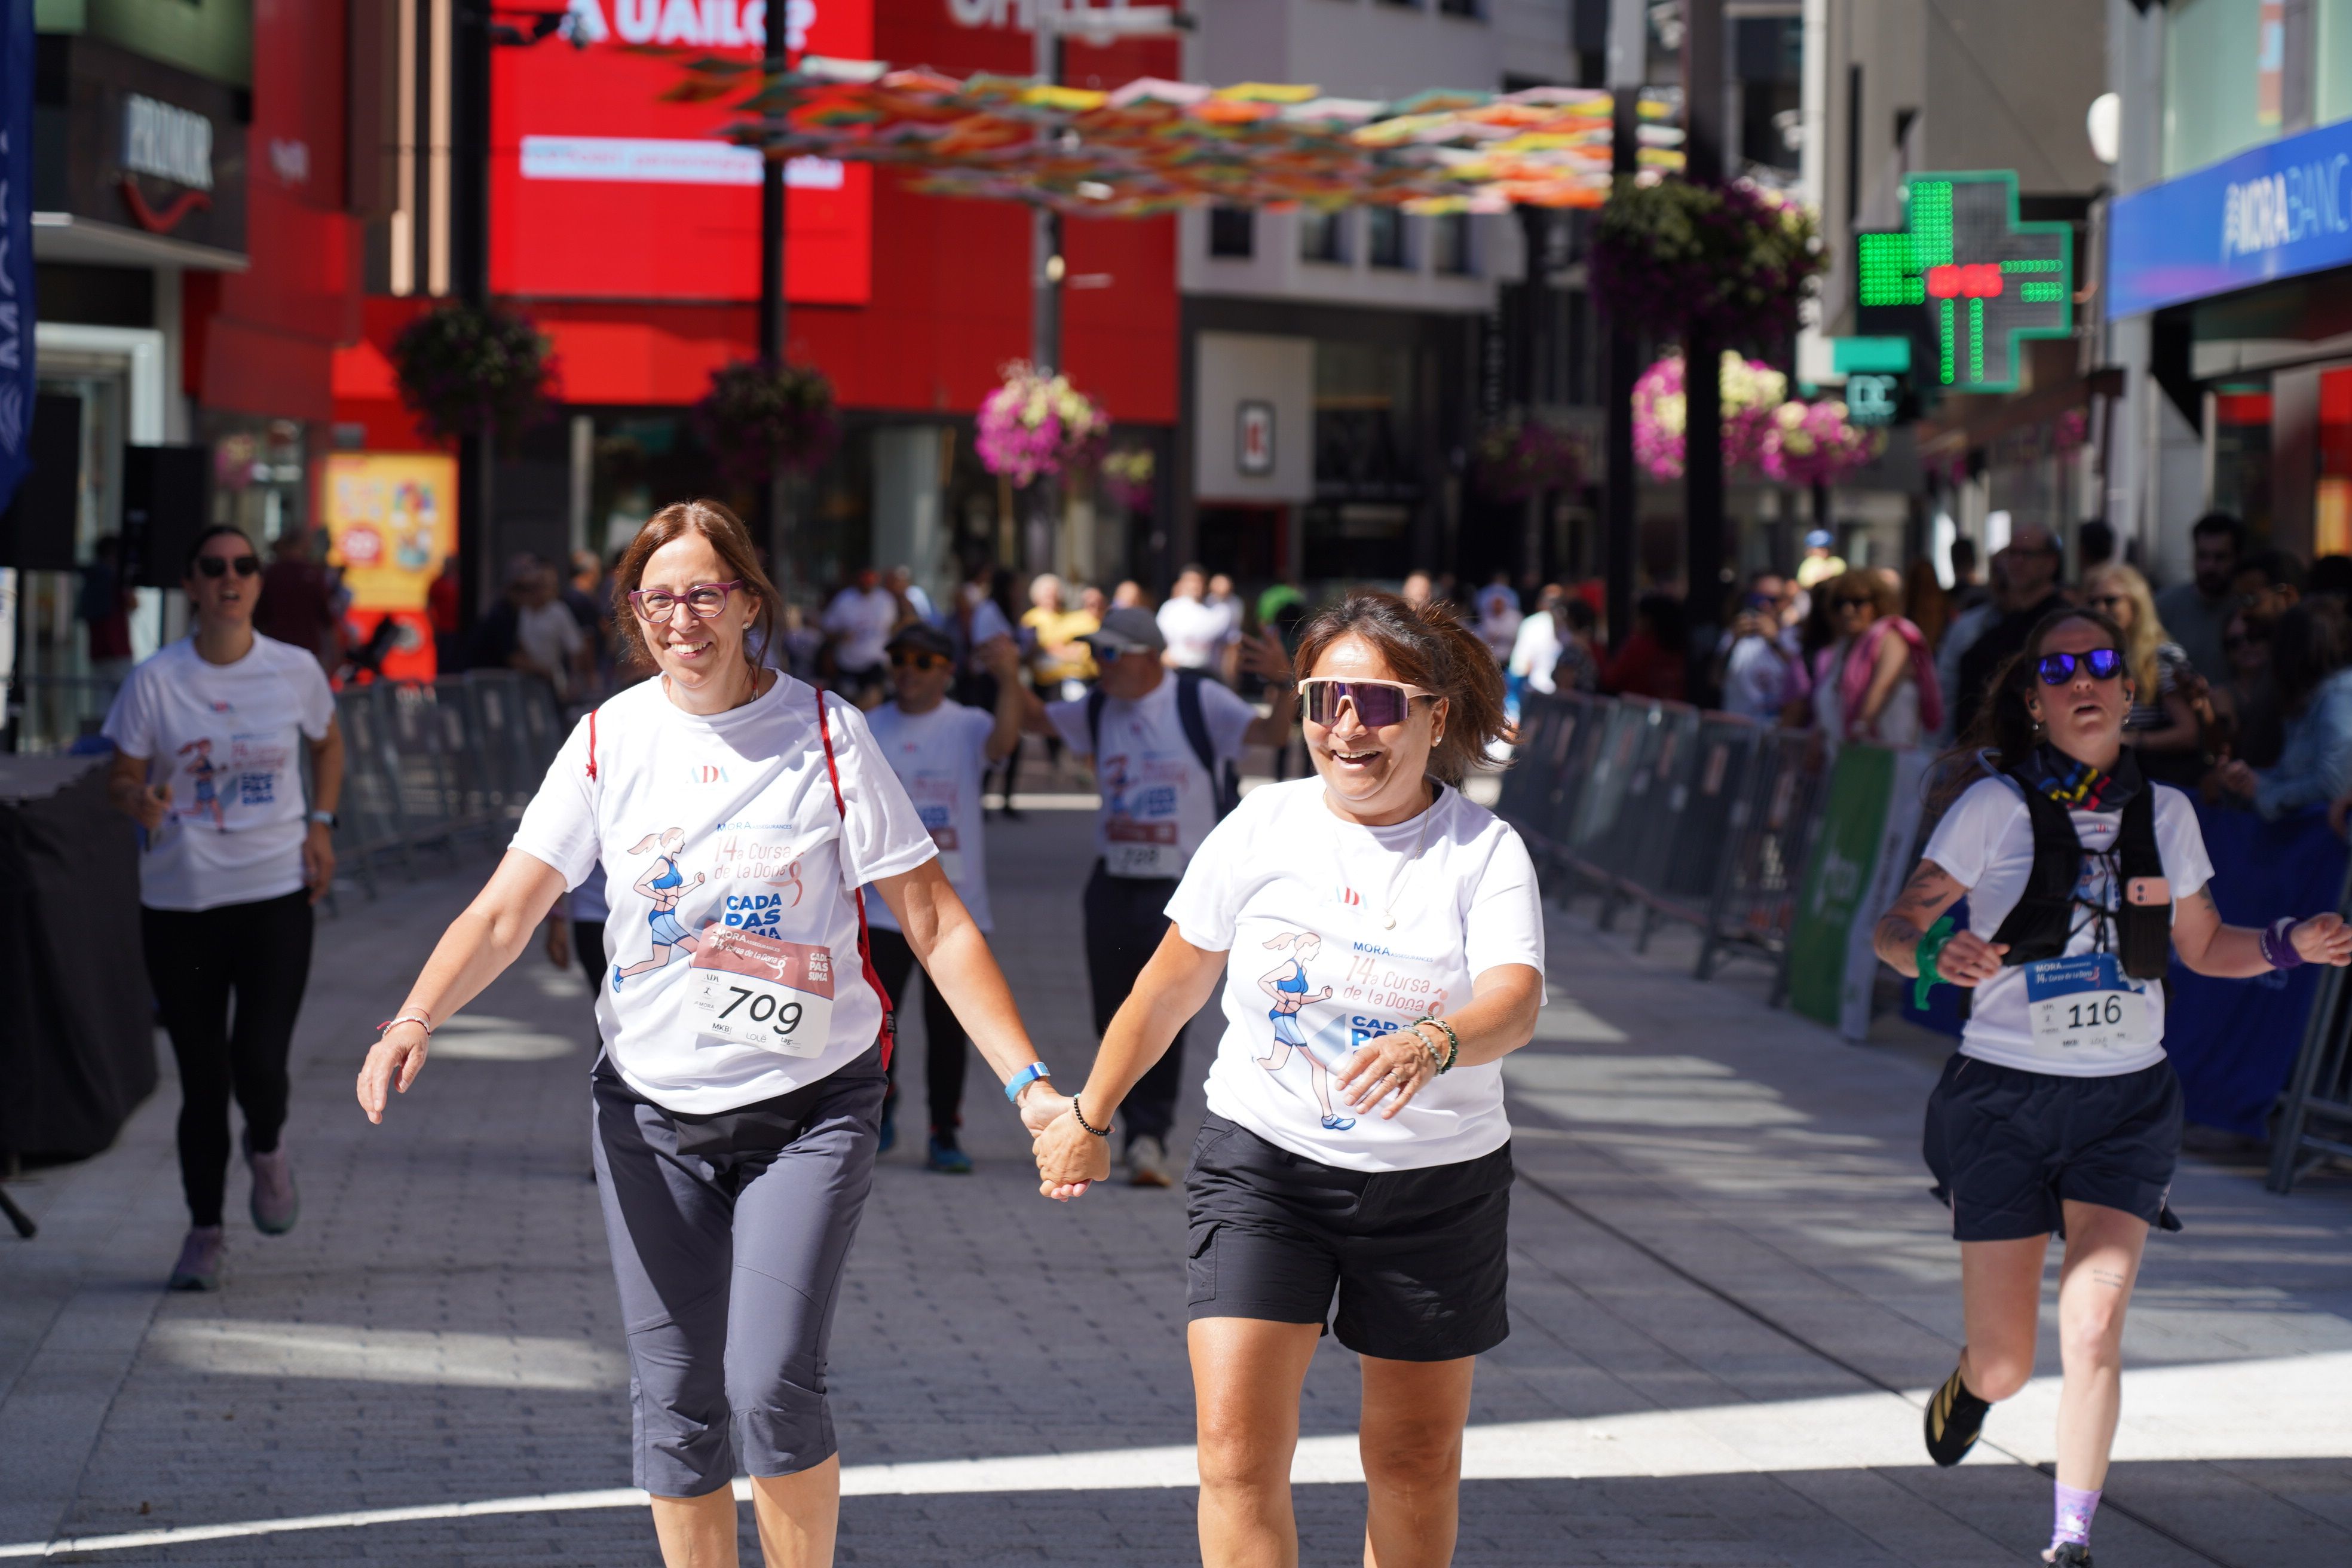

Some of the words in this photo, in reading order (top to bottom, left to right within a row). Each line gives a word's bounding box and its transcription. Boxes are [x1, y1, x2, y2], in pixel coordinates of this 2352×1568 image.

[749, 843, 791, 859] Cursa
[714, 864, 730, 879] de
[737, 863, 751, 878] la
[754, 862, 788, 878] Dona
[727, 893, 782, 911] CADA
[745, 949, 753, 957] de
[761, 954, 778, 964] Dona
[1353, 942, 1390, 956] MORA
[809, 961, 829, 972] PAS
[808, 972, 828, 982] SUMA
[1383, 971, 1431, 994] Cursa
[1343, 985, 1362, 1000] de
[1367, 989, 1384, 1005] la
[1385, 992, 1425, 1012] Dona
[718, 986, 803, 1035] 709
[2069, 994, 2121, 1029] 116
[1352, 1016, 1414, 1030] CAD
